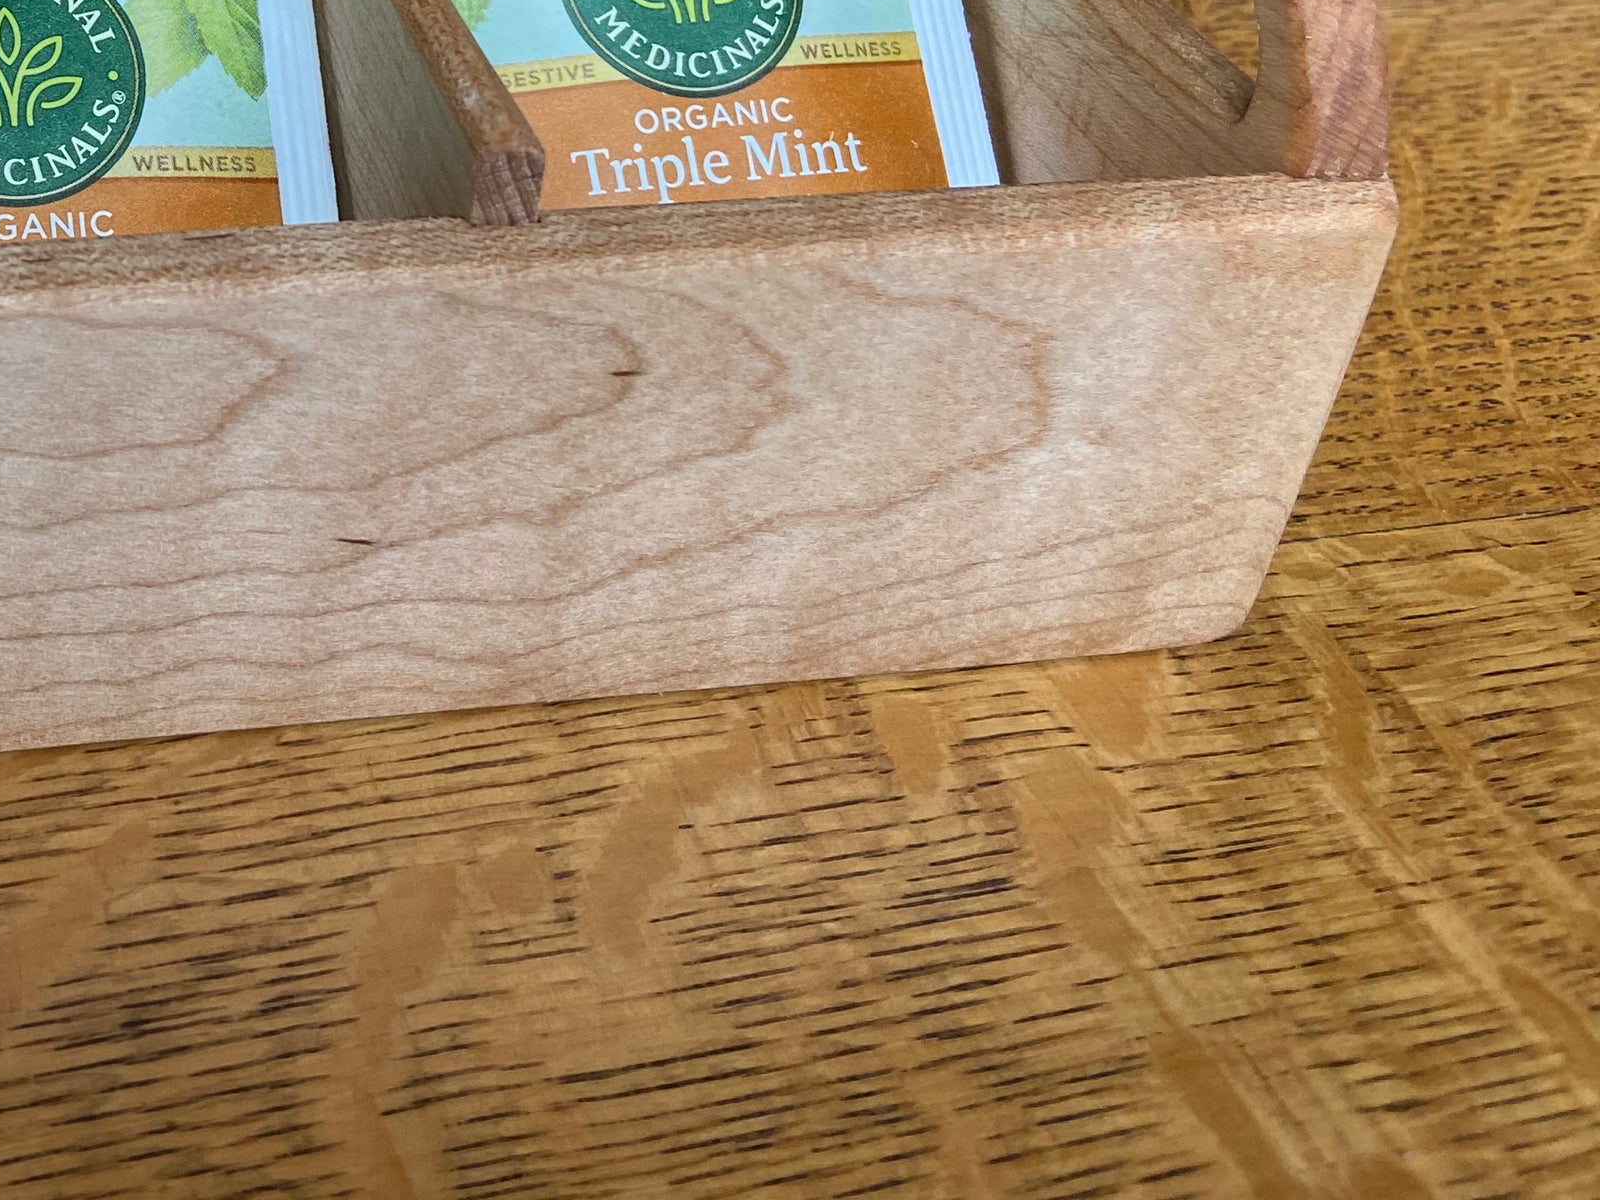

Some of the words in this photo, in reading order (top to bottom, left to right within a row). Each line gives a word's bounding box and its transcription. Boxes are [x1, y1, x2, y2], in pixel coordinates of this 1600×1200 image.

[499, 62, 596, 89] GESTIVE
[801, 40, 901, 60] WELLNESS
[634, 97, 794, 135] ORGANIC
[132, 154, 257, 172] WELLNESS
[570, 135, 732, 205] Triple
[741, 128, 868, 182] Mint
